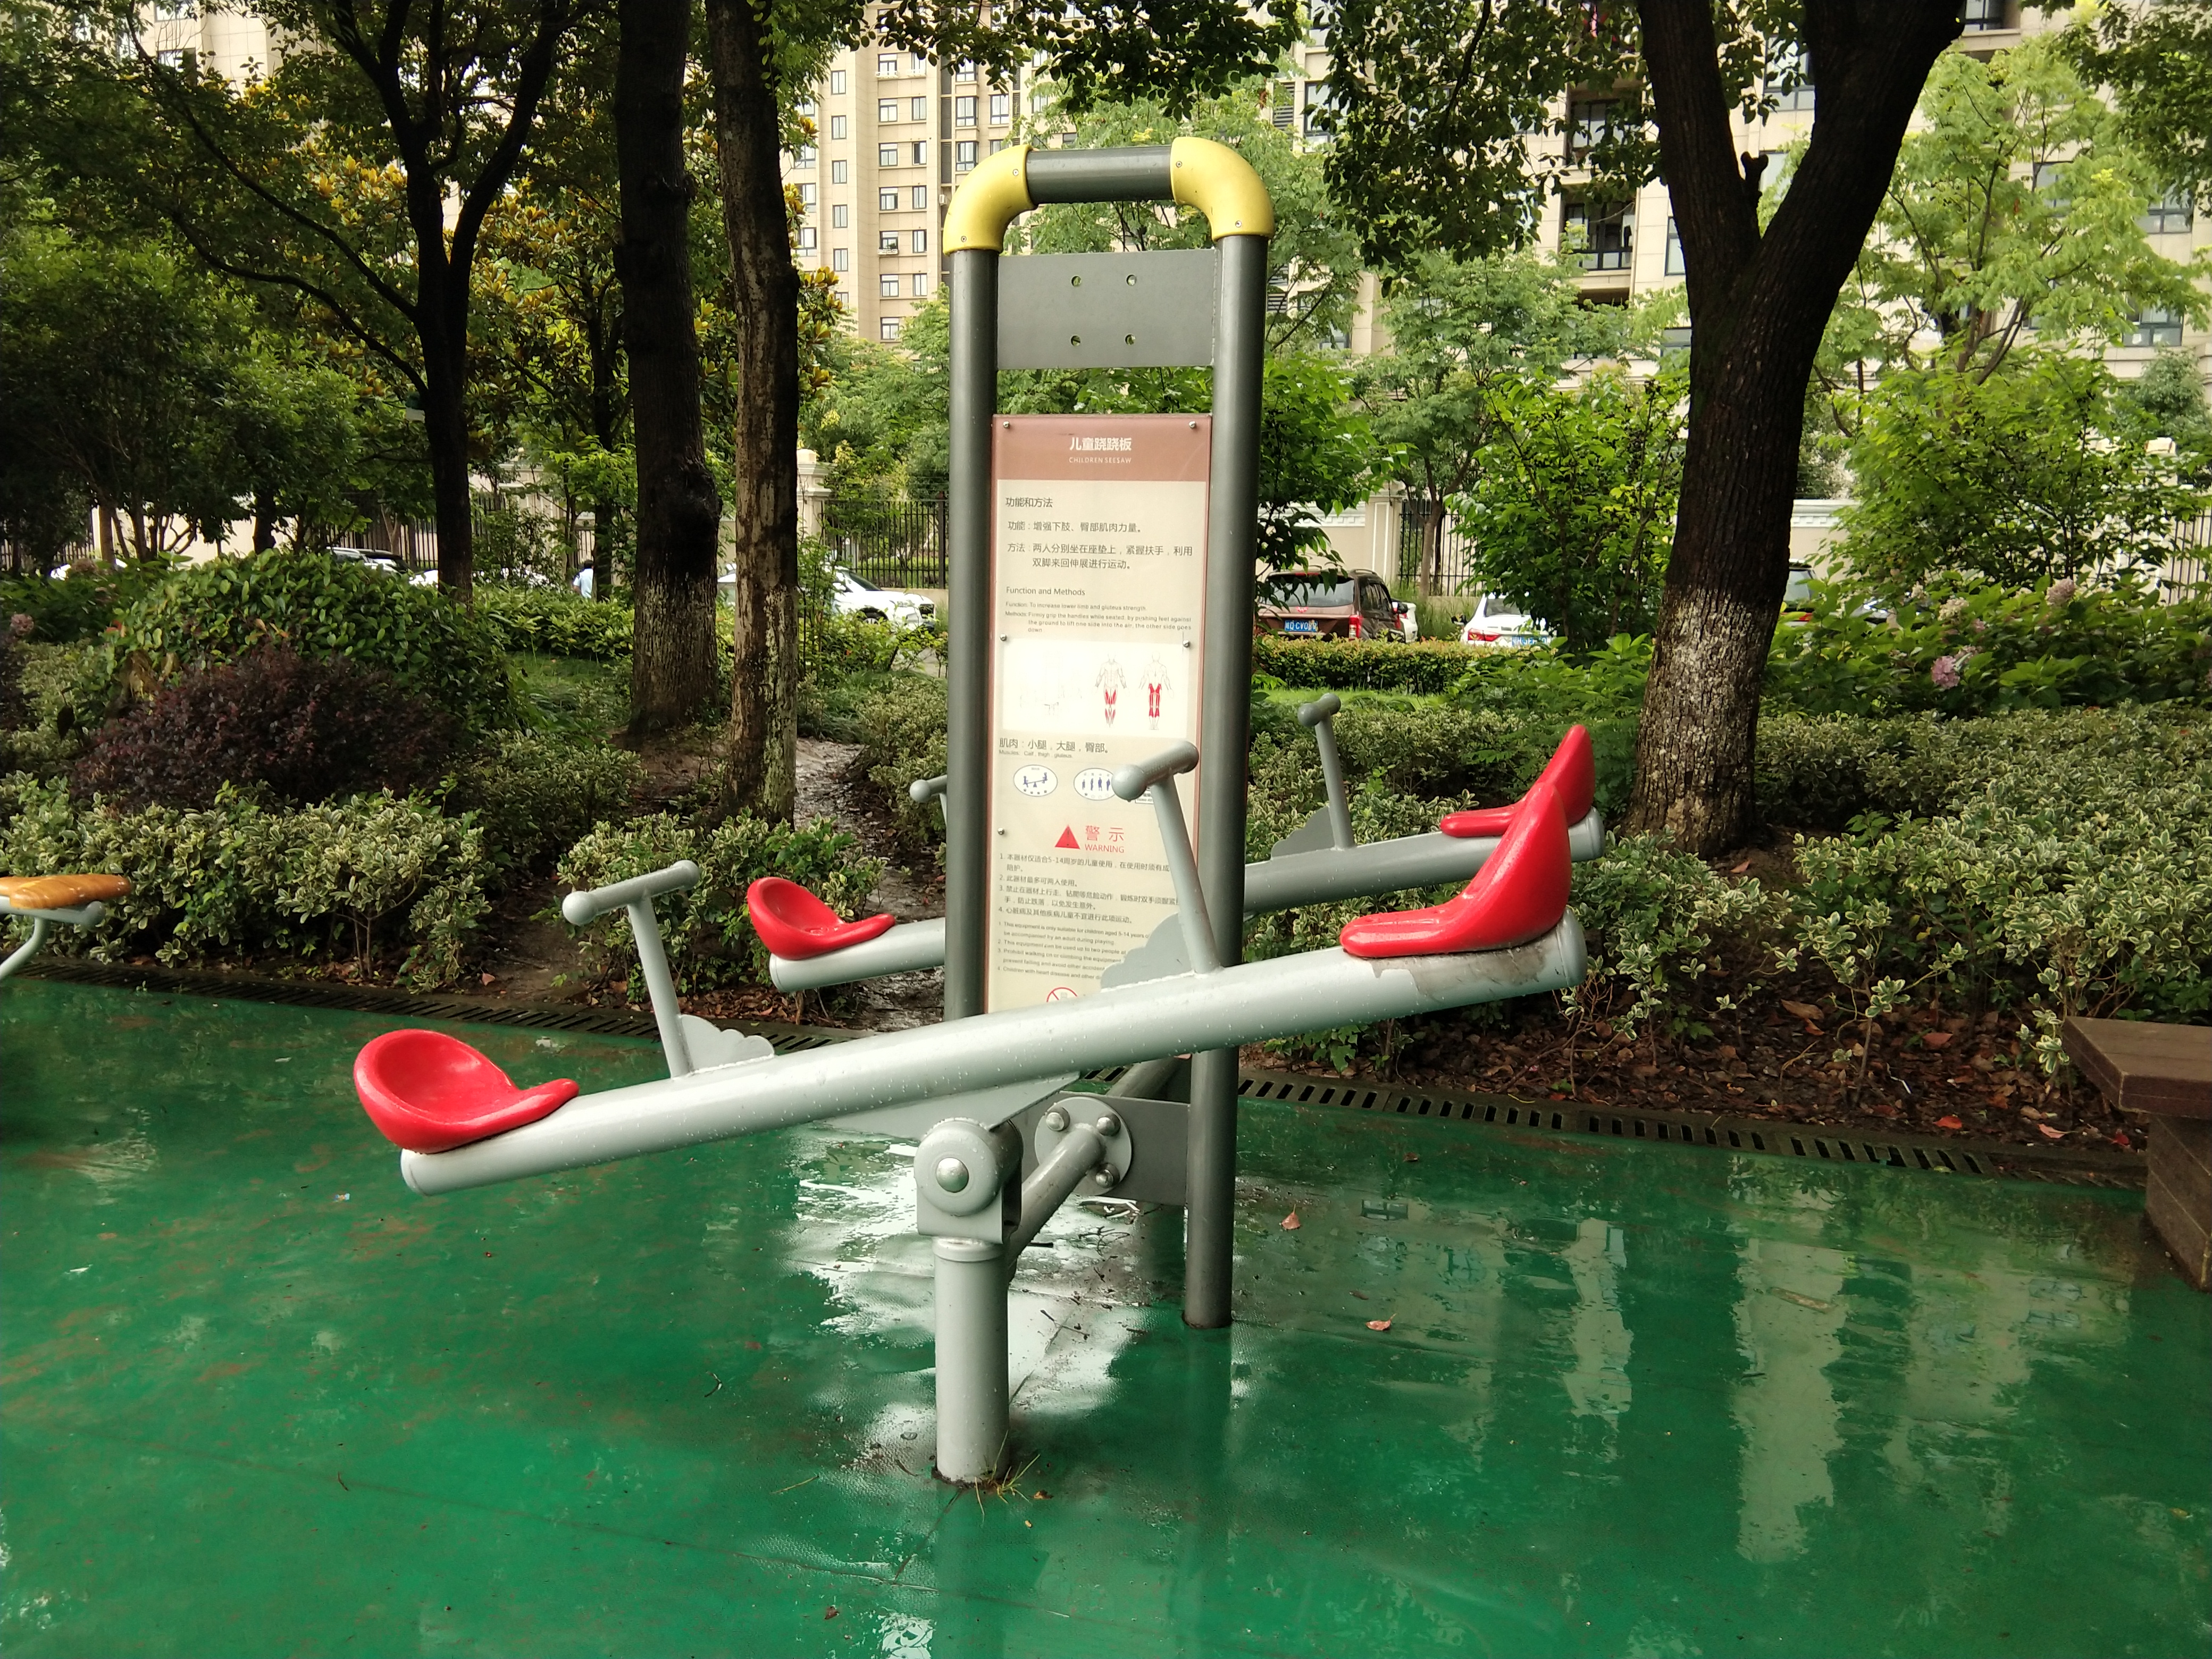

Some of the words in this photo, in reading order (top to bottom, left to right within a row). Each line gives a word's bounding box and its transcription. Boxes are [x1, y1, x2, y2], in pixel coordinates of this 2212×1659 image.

[1069, 437, 1132, 451] 儿童跷跷板
[1006, 497, 1053, 508] 功能和方法
[1085, 825, 1124, 842] 警示
[1085, 843, 1124, 853] WARNING
